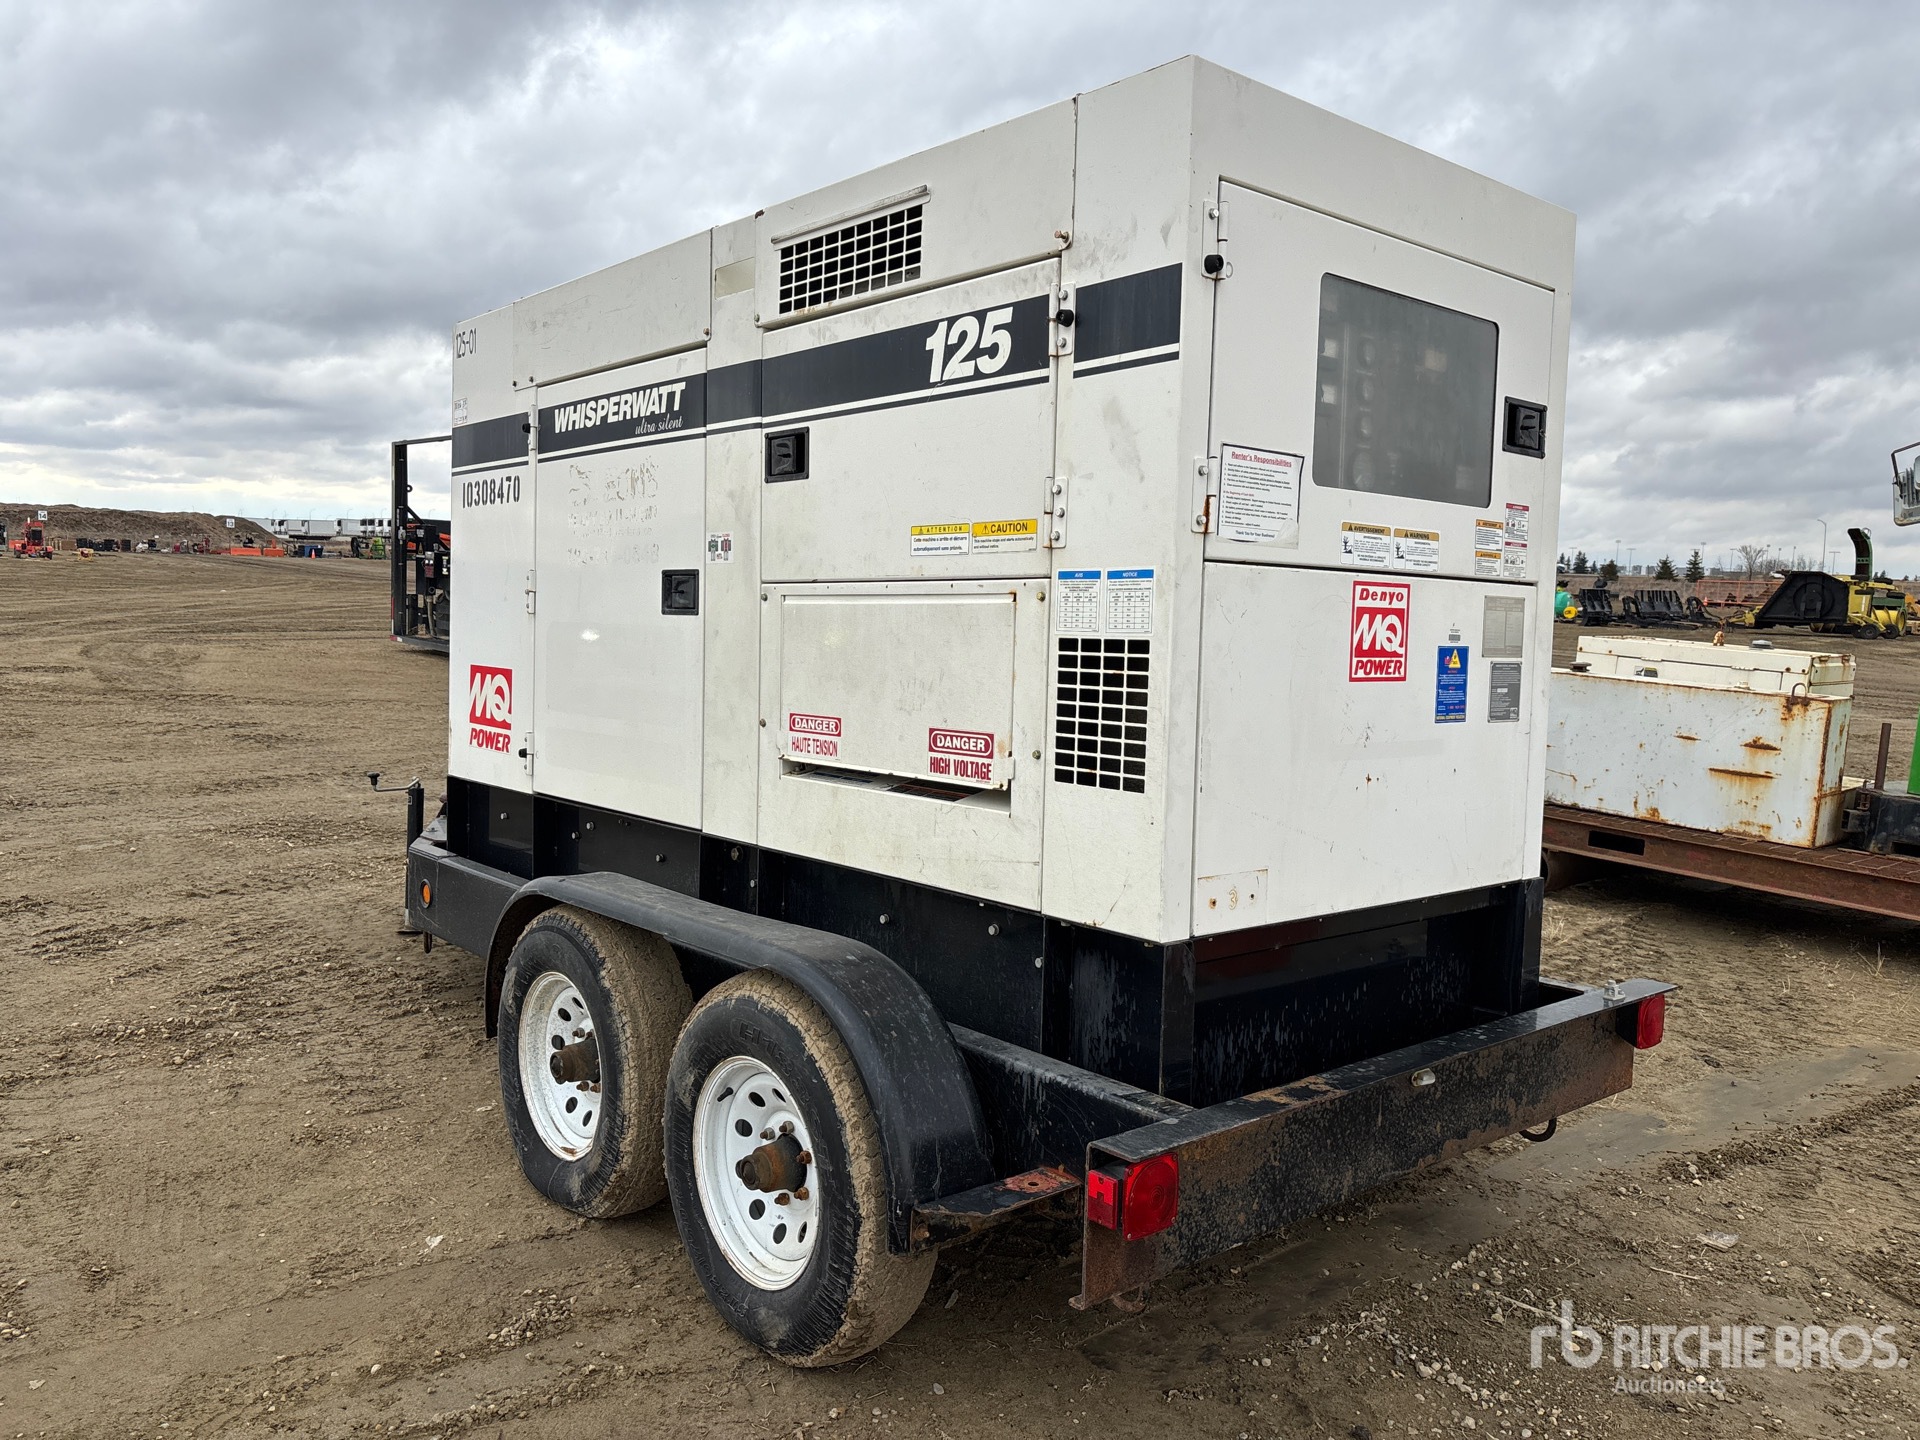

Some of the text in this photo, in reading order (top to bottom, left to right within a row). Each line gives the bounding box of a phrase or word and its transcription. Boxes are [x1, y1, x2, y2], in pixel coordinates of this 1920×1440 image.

[456, 327, 477, 359] 125-01
[925, 306, 1013, 383] 125
[554, 381, 687, 434] WHISPERWATT
[635, 413, 683, 435] ultra silent
[1231, 451, 1292, 468] Renter's Responsibilities
[990, 522, 1028, 534] CAUTION
[1354, 526, 1386, 534] AVERTISSEMENT
[1409, 532, 1430, 540] WARNING
[1358, 587, 1405, 606] Denyo
[1354, 613, 1404, 655] MQ
[1353, 658, 1403, 676] POWER
[469, 672, 512, 724] MQ
[794, 716, 836, 732] DANGER
[469, 727, 511, 753] POWER
[791, 736, 838, 757] HAUTE TENSION
[936, 735, 986, 752] DANGER
[929, 756, 992, 781] HIGH VOLTAGE
